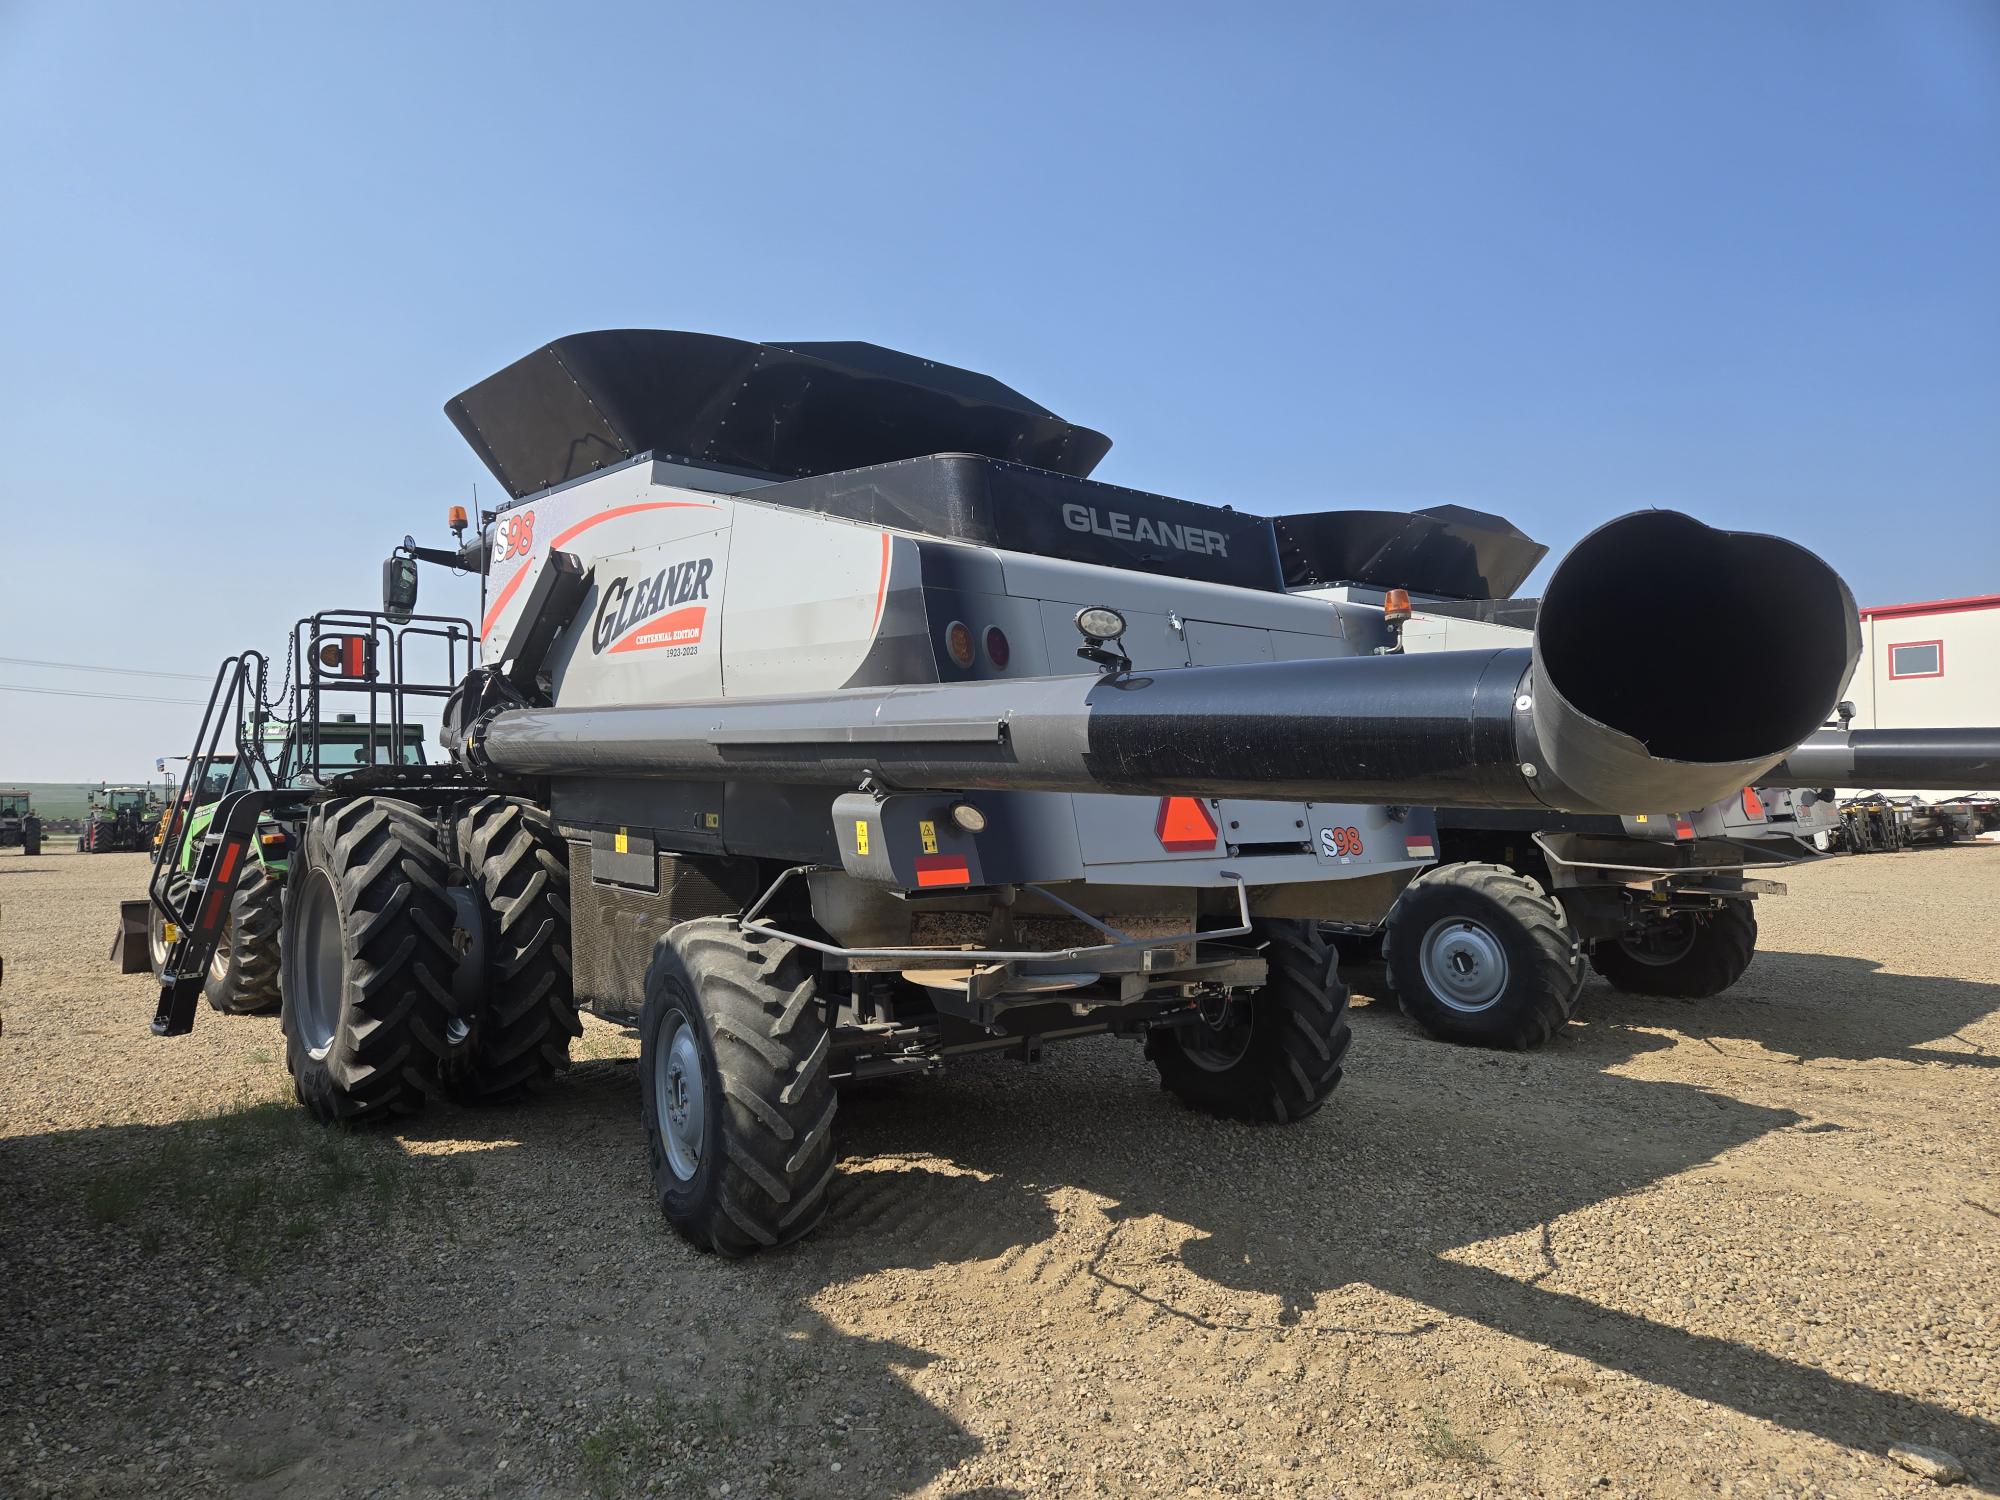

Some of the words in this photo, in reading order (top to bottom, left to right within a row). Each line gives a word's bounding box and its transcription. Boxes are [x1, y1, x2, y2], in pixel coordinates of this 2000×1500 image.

[493, 510, 535, 563] S98
[1062, 503, 1228, 558] GLEANER
[592, 558, 714, 656] GLEANER
[635, 632, 672, 645] CENTENNIAL
[673, 628, 700, 640] EDITION
[666, 646, 698, 658] 1923-2023
[1320, 826, 1363, 857] S98
